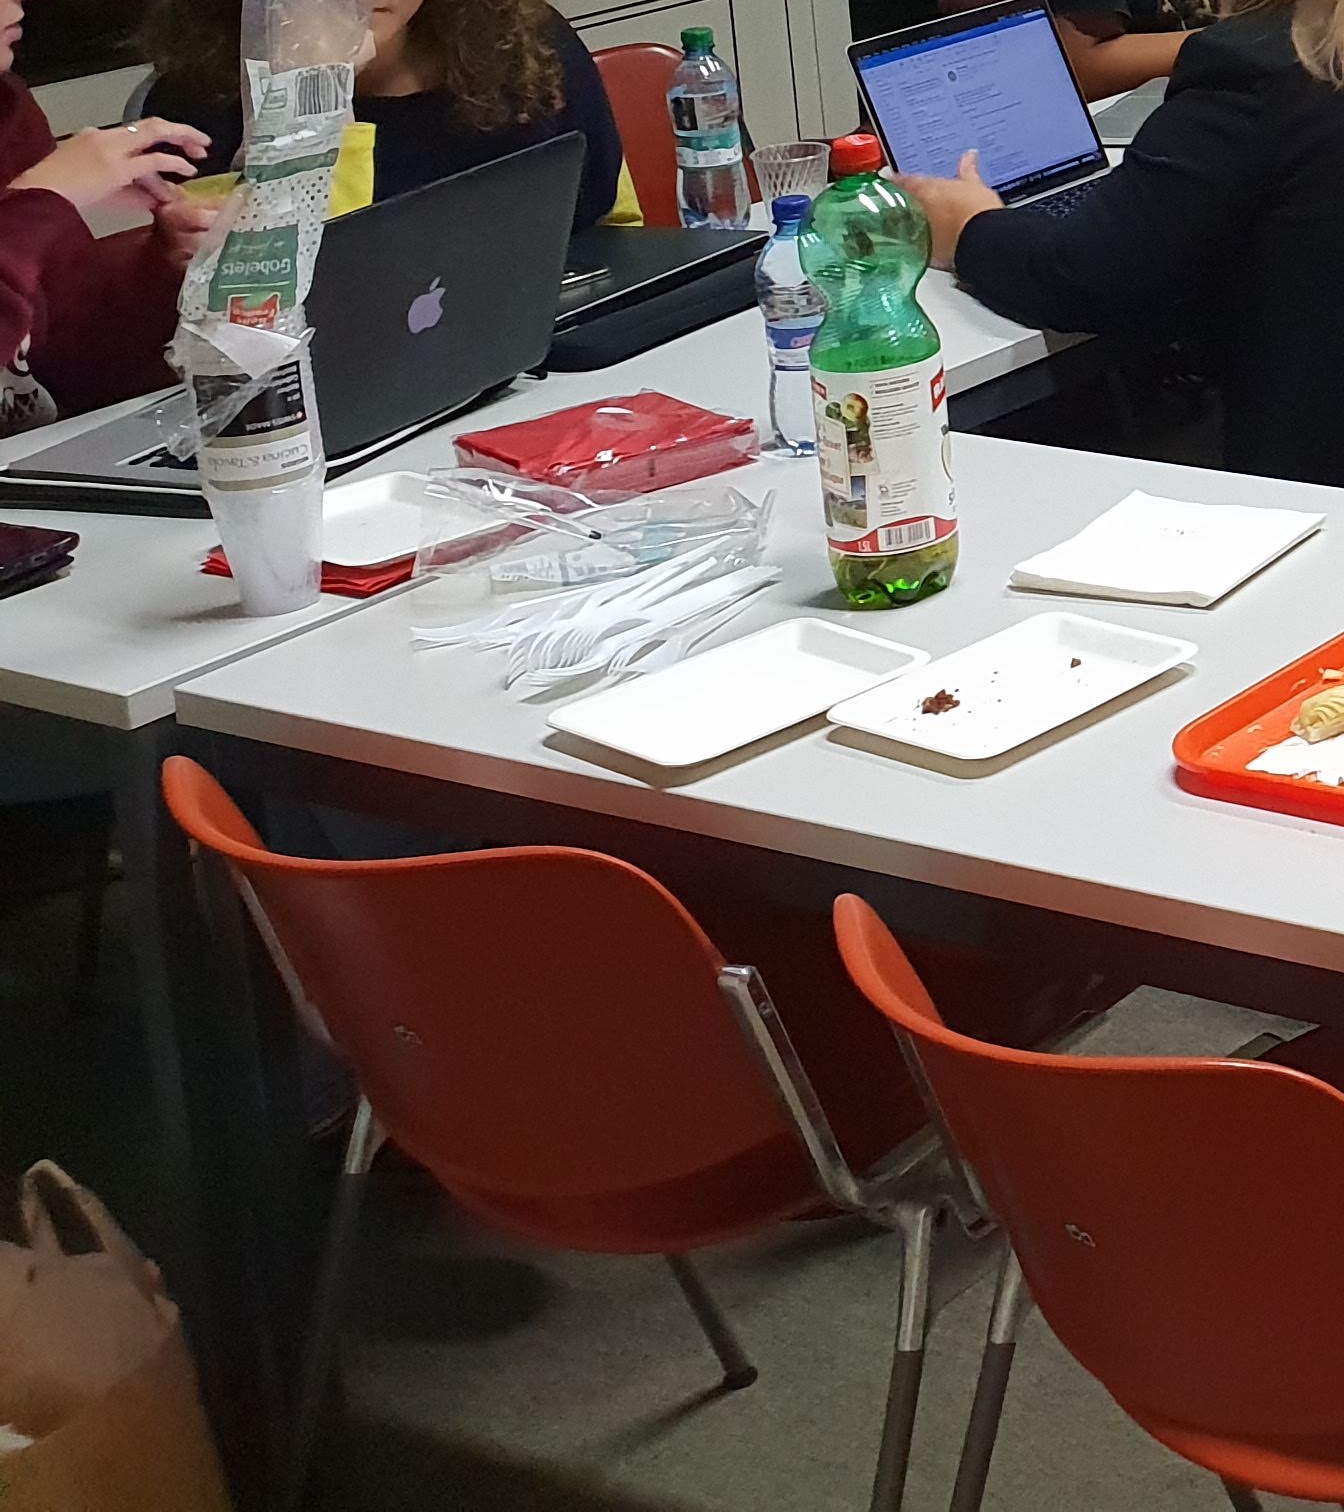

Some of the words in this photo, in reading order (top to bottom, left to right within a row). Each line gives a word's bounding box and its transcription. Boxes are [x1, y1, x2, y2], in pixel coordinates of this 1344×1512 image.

[221, 258, 291, 276] Gobelets
[246, 454, 260, 466] &
[262, 443, 308, 462] Cucina
